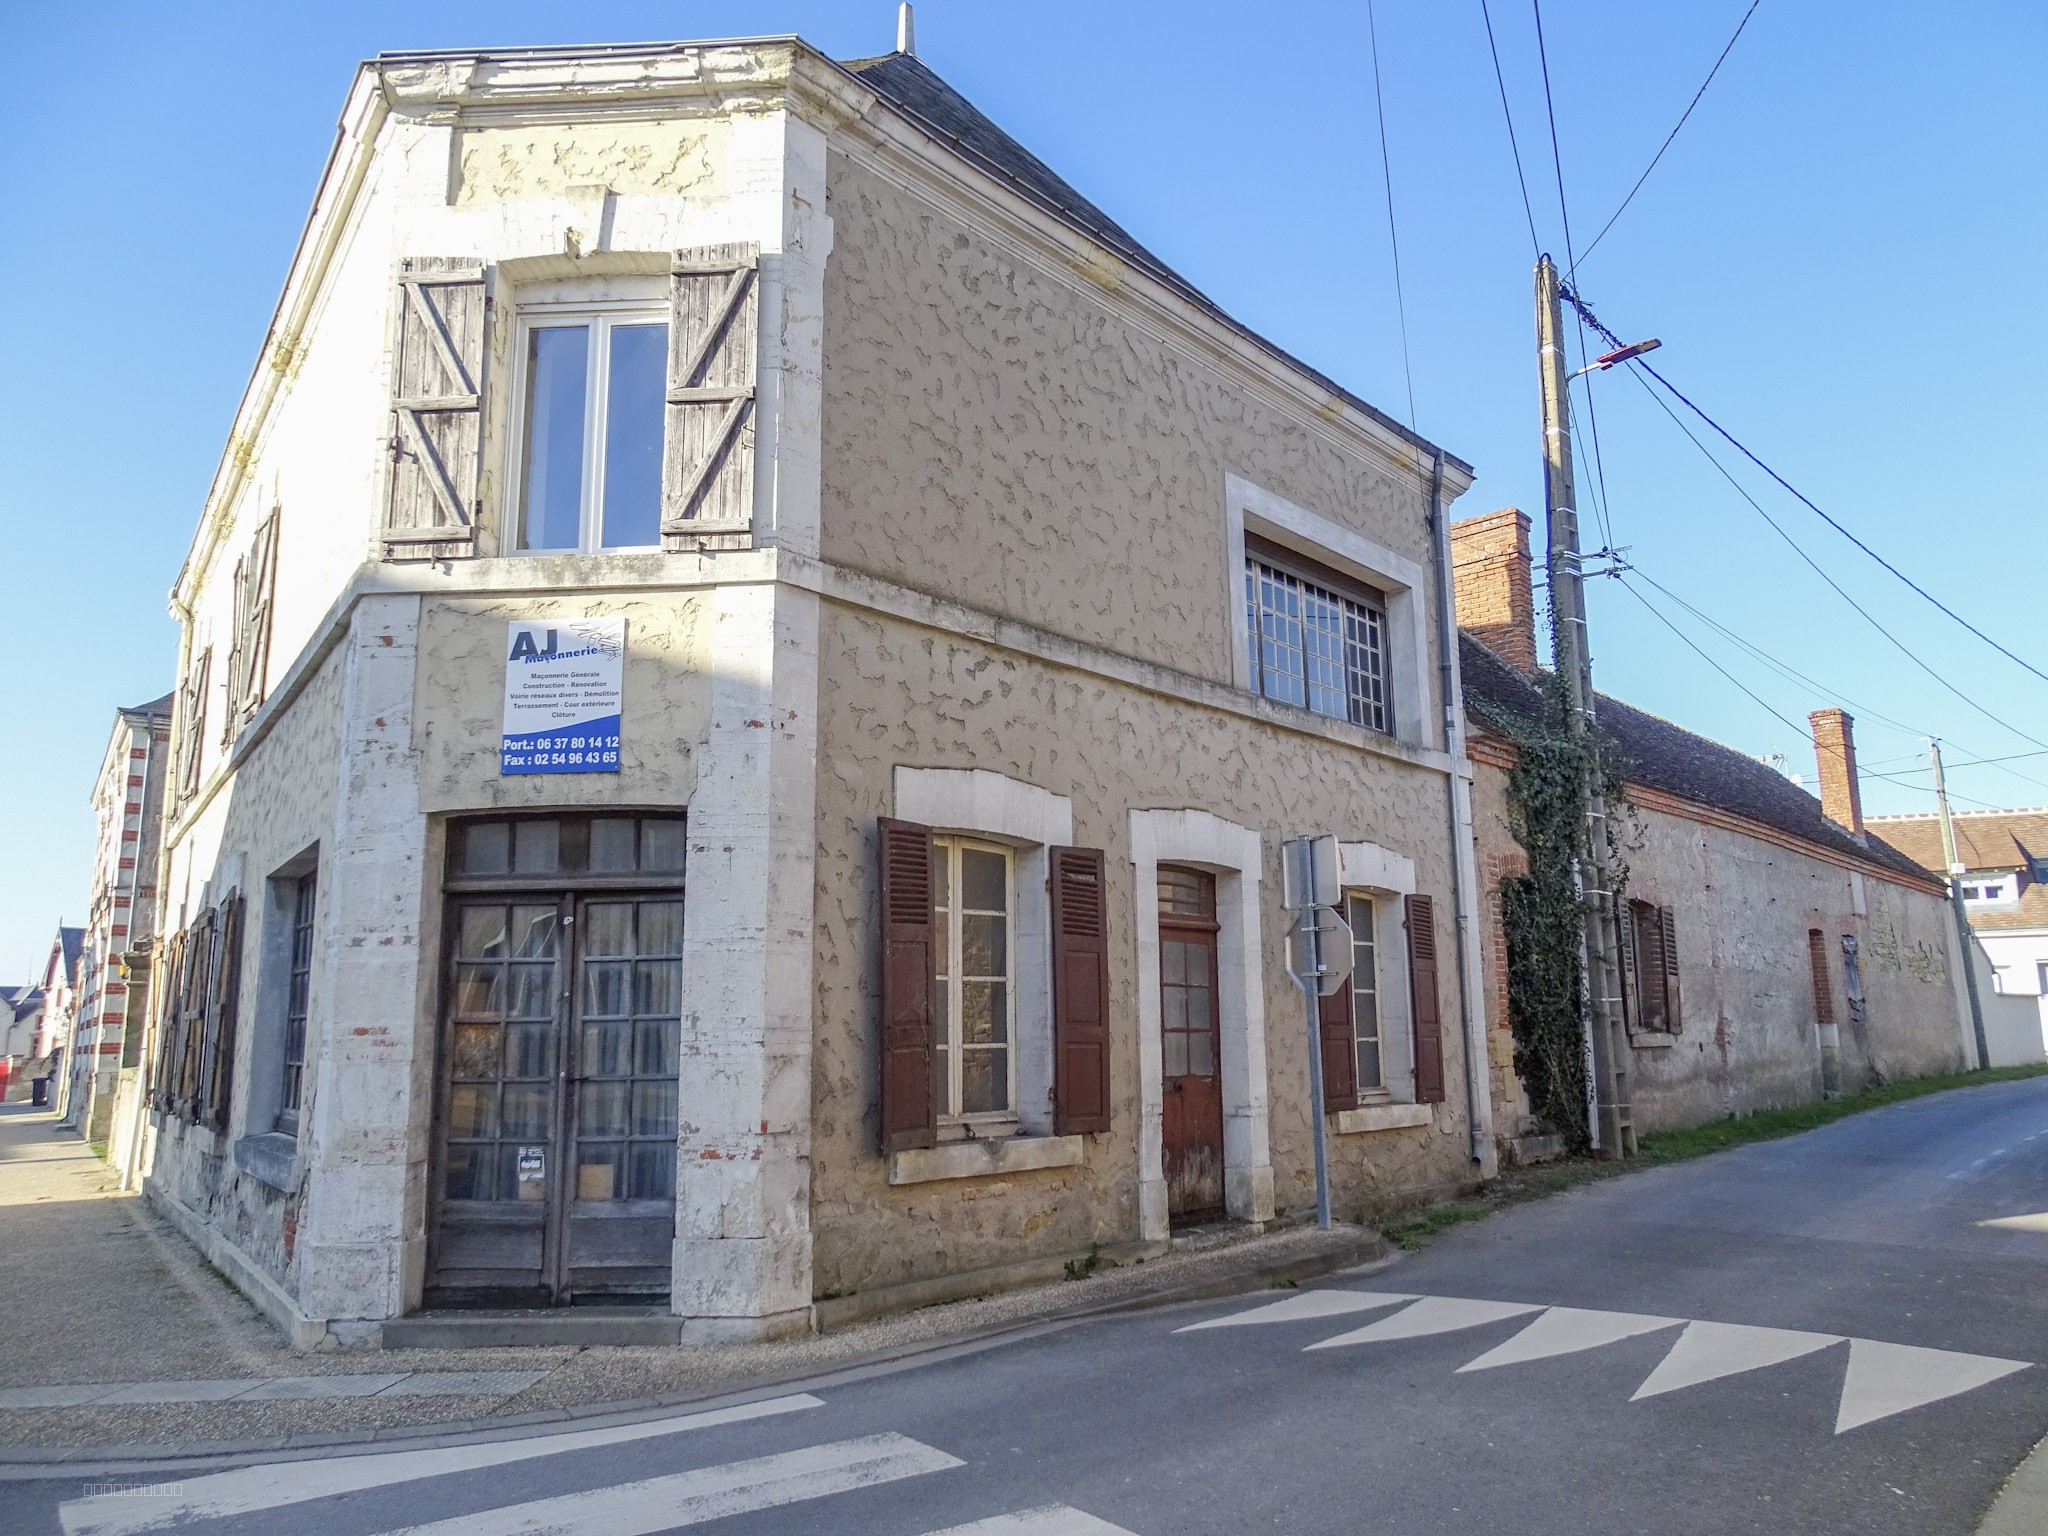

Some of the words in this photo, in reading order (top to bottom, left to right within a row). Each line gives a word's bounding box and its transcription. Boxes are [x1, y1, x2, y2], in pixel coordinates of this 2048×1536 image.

[509, 629, 557, 661] AJ
[525, 645, 598, 664] Maçonnerie
[531, 672, 569, 680] Maçonnerie
[530, 691, 557, 699] réseaux
[558, 690, 578, 698] divers
[537, 738, 551, 749] 06
[554, 738, 568, 749] 37
[571, 737, 585, 748] 80
[588, 736, 602, 748] 14
[605, 736, 619, 747] 12
[504, 754, 525, 765] Fax
[534, 753, 549, 765] 02
[551, 753, 566, 764] 54
[568, 752, 583, 764] 96
[585, 752, 600, 763] 43
[602, 751, 617, 763] 65
